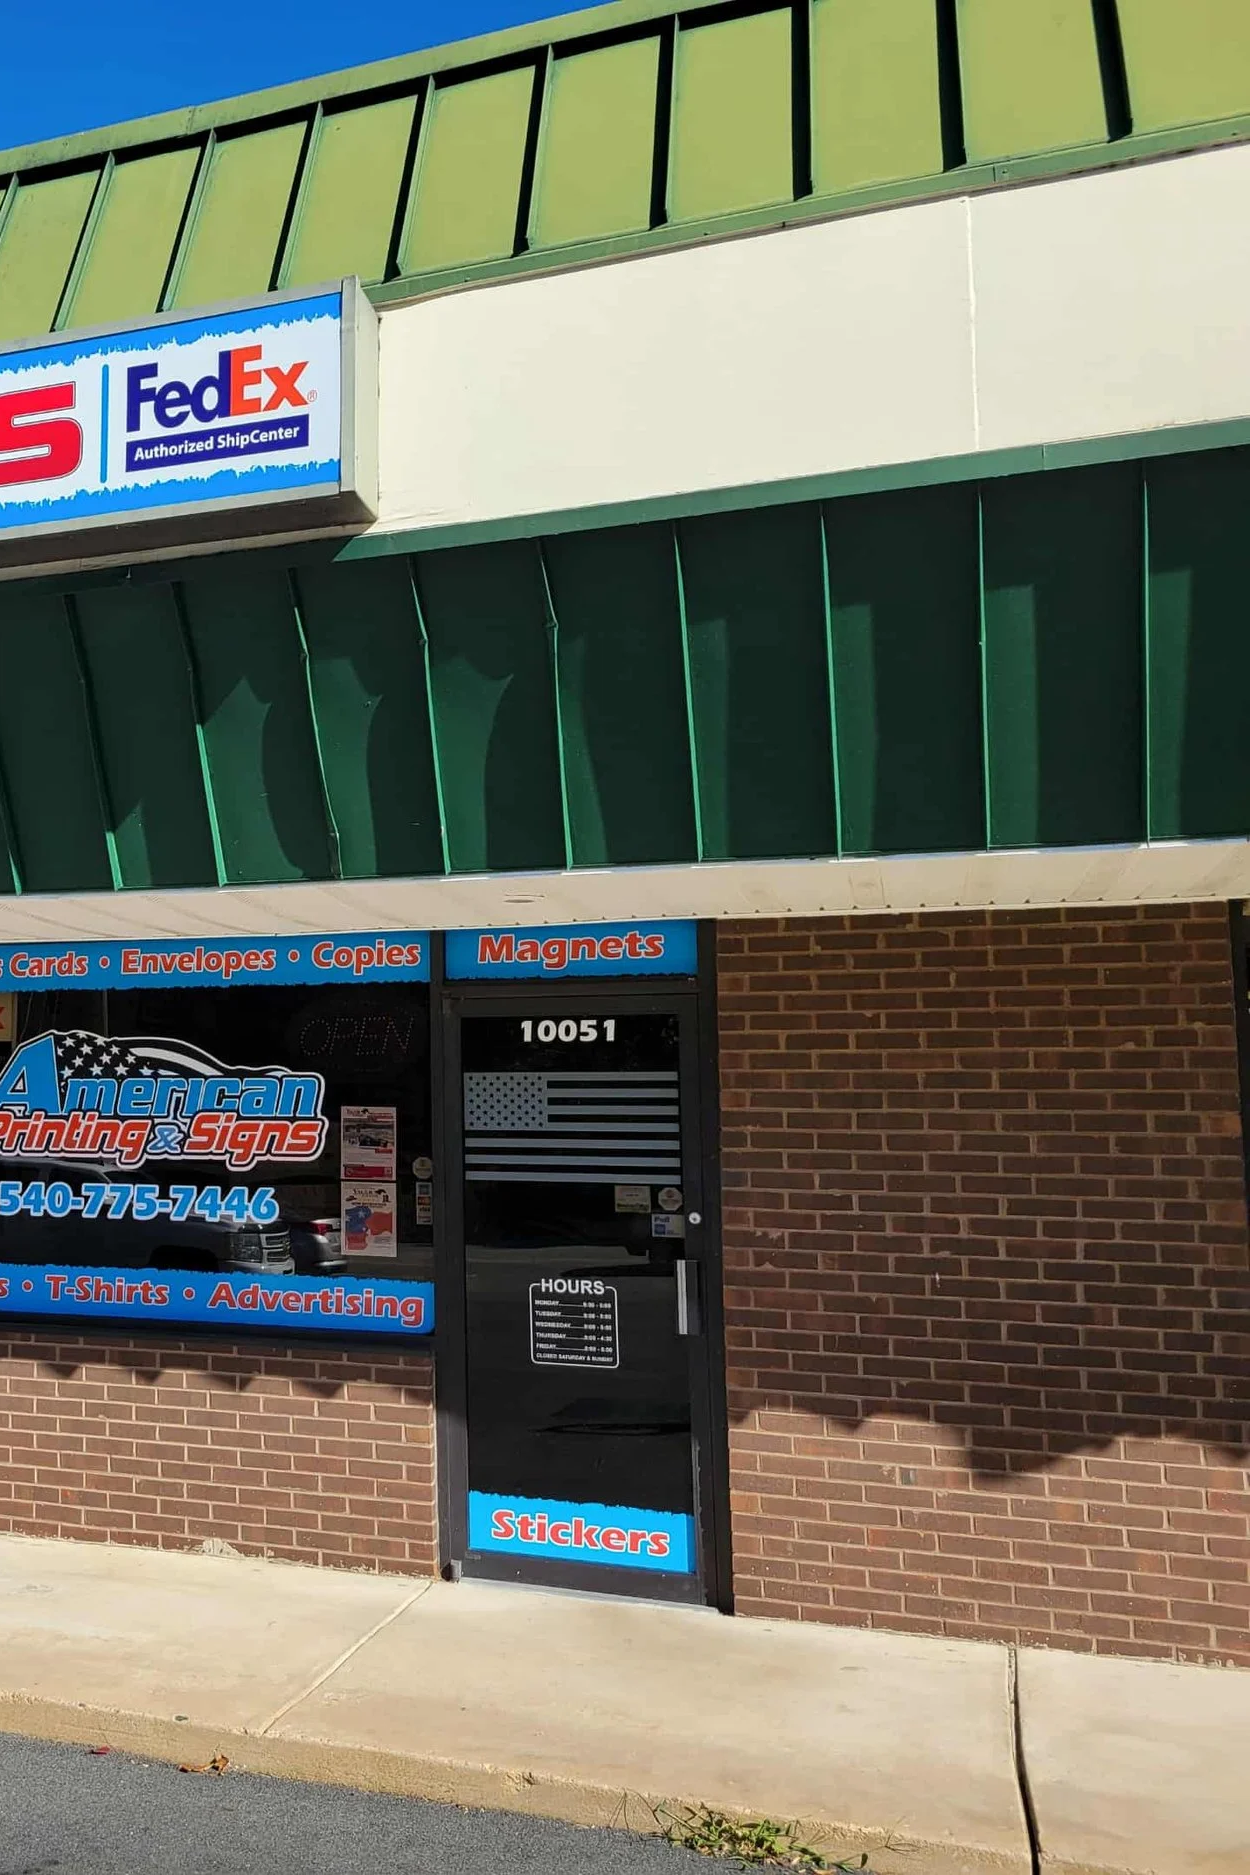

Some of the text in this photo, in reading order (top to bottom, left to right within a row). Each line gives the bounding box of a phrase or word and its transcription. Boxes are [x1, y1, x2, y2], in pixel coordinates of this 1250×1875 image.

[126, 344, 310, 433] FedEx
[134, 425, 300, 461] Authorized ShipCenter
[9, 951, 88, 977] Cards
[120, 946, 276, 980] Envelopes
[312, 939, 421, 976] Copies
[478, 931, 665, 970] Magnets
[299, 1016, 414, 1056] OPEN
[520, 1019, 616, 1042] 10051
[147, 1123, 184, 1153] &
[184, 1111, 327, 1165] Signs
[45, 1274, 170, 1305] T-Shirts
[207, 1282, 424, 1328] Advertising
[541, 1278, 605, 1295] HOURS
[491, 1509, 670, 1556] Stickers
